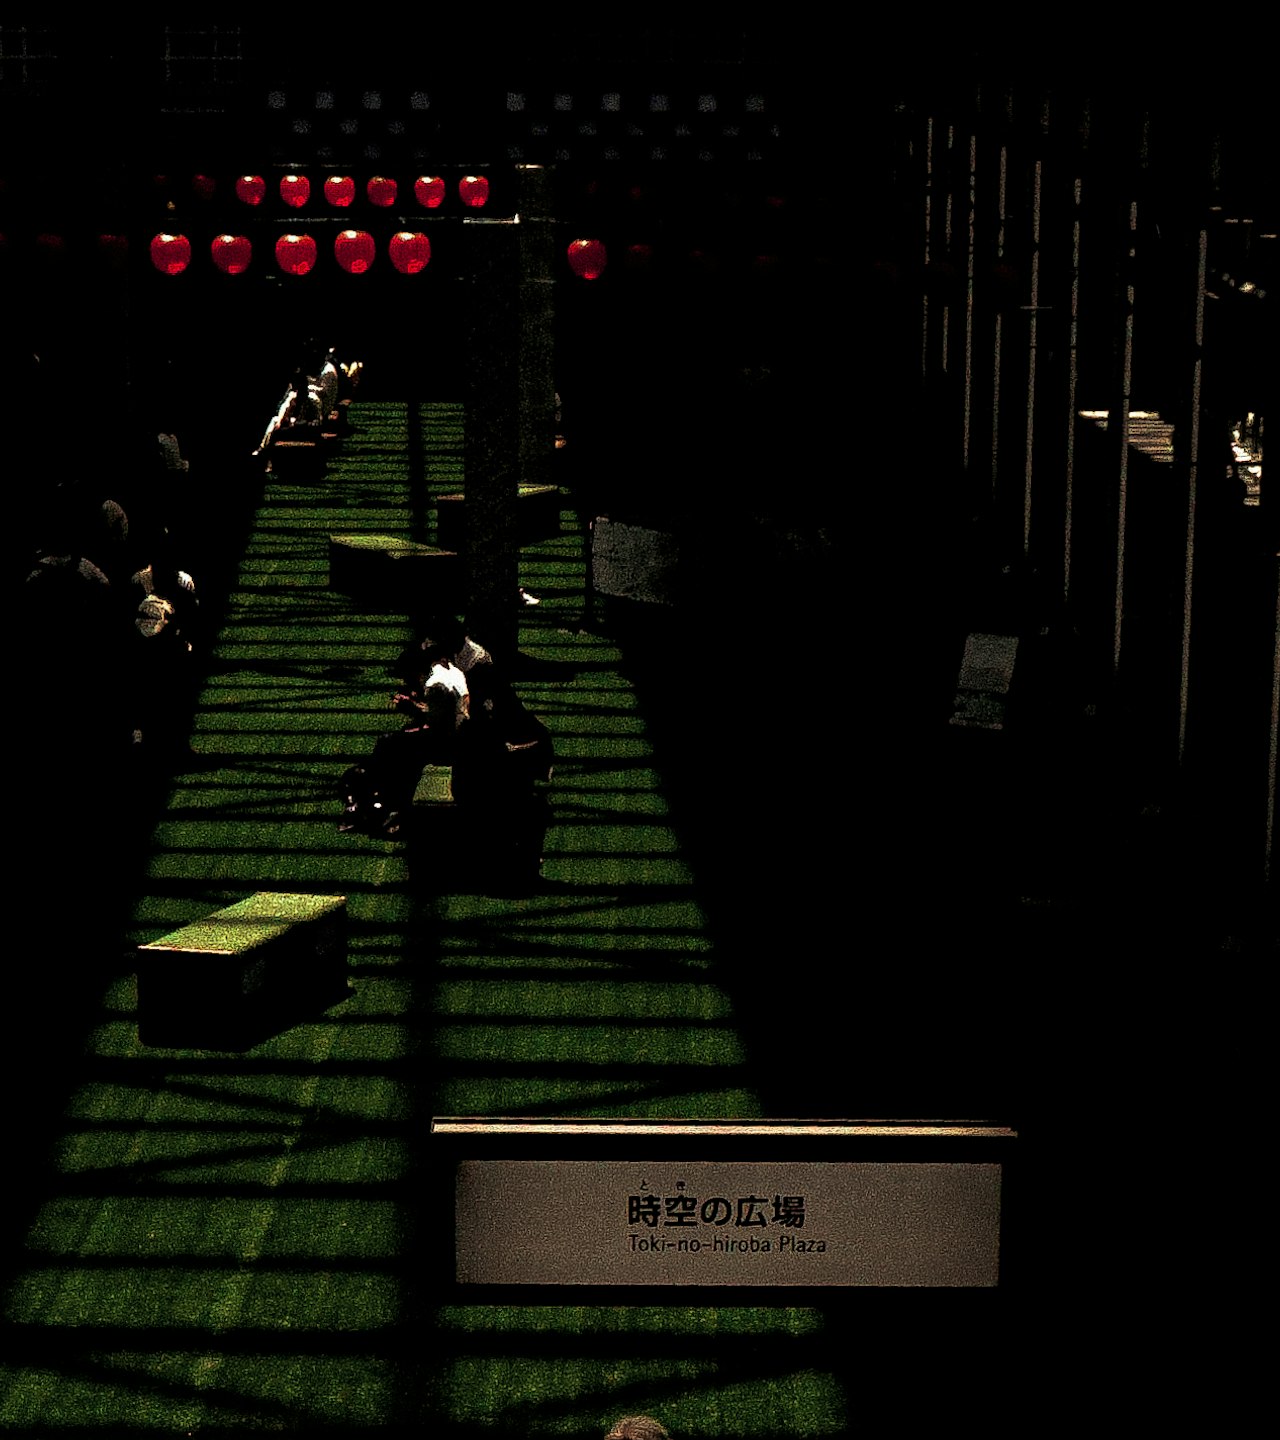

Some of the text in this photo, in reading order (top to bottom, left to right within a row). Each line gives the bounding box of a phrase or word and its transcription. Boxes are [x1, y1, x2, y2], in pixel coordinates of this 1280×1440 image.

[628, 1194, 806, 1228] 時空の広場
[628, 1234, 826, 1253] Toki-no-hiroba Plaza
